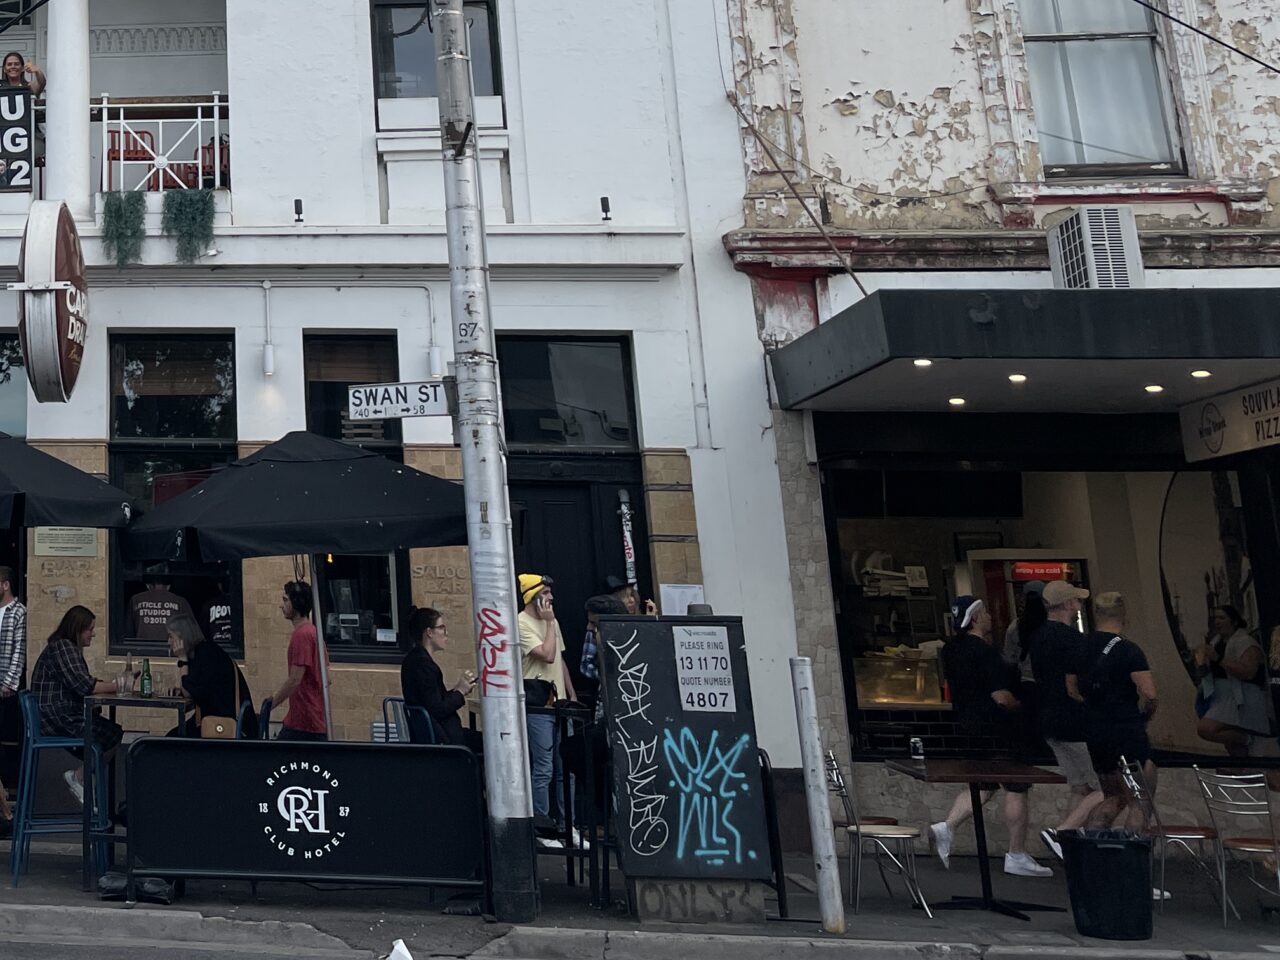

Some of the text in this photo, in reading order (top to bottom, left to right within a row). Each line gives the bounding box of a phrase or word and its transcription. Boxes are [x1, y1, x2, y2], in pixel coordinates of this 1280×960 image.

[0, 95, 25, 121] U
[10, 161, 31, 186] 2
[459, 323, 478, 337] 67
[352, 384, 440, 406] SWAN ST
[41, 559, 92, 578] BAR
[680, 641, 724, 650] PLEASE RING
[680, 656, 728, 670] 13 11 70
[680, 676, 731, 686] QUOTE NUMBER
[686, 692, 729, 708] 4807
[266, 761, 339, 788] RICHMOND
[258, 802, 269, 813] 18
[338, 806, 350, 817] 87
[264, 826, 346, 859] CLUB HOTEL
